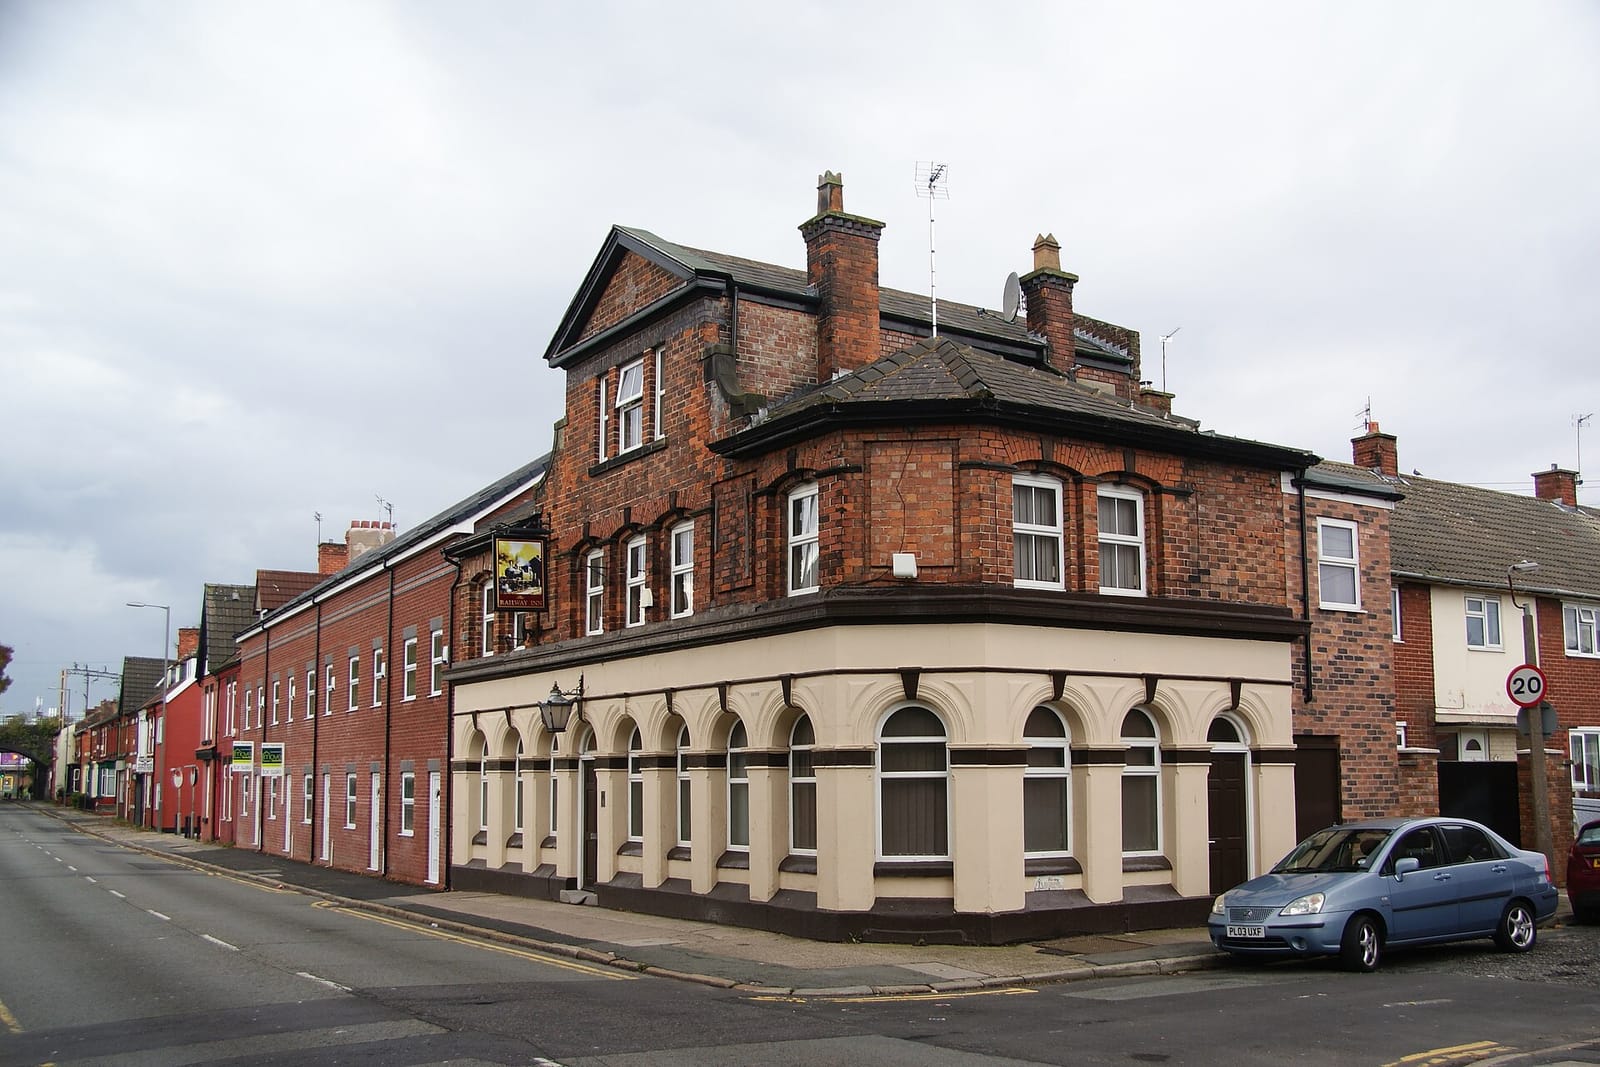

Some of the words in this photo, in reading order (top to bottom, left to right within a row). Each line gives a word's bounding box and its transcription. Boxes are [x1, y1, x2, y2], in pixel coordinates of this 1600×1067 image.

[1512, 676, 1541, 695] 20
[1229, 927, 1247, 936] PL03
[1247, 927, 1262, 937] UXF
